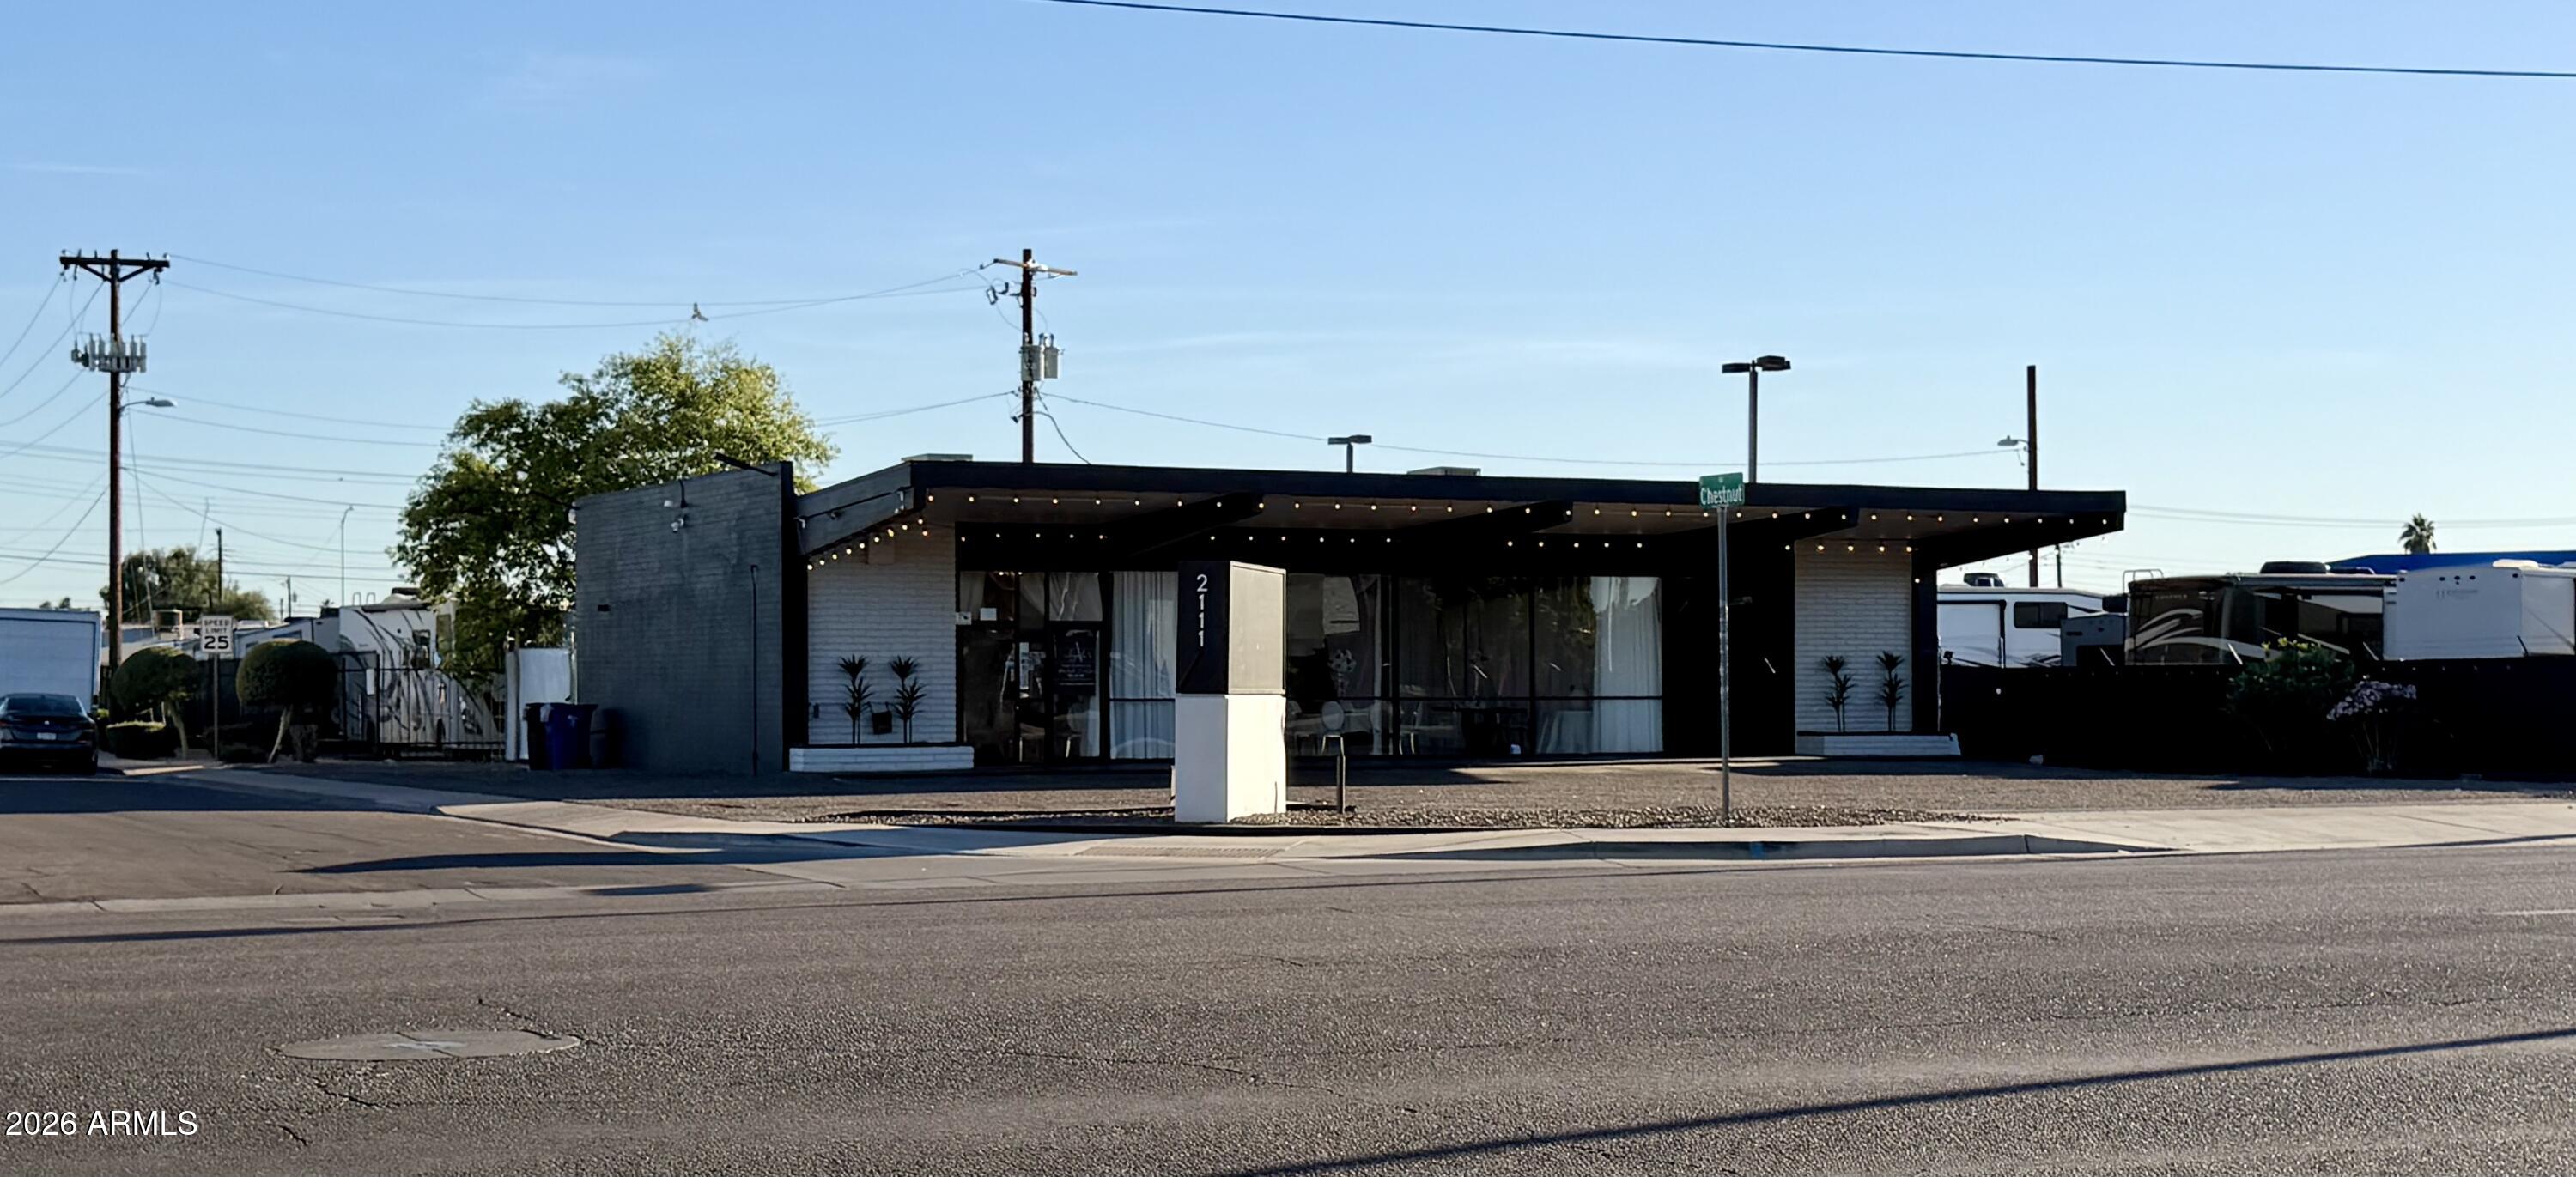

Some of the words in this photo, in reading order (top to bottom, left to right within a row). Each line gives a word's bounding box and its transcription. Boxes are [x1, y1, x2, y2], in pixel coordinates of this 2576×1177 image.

[1700, 485, 1743, 505] Chestnut
[1196, 573, 1208, 647] 2111
[204, 635, 228, 649] 25
